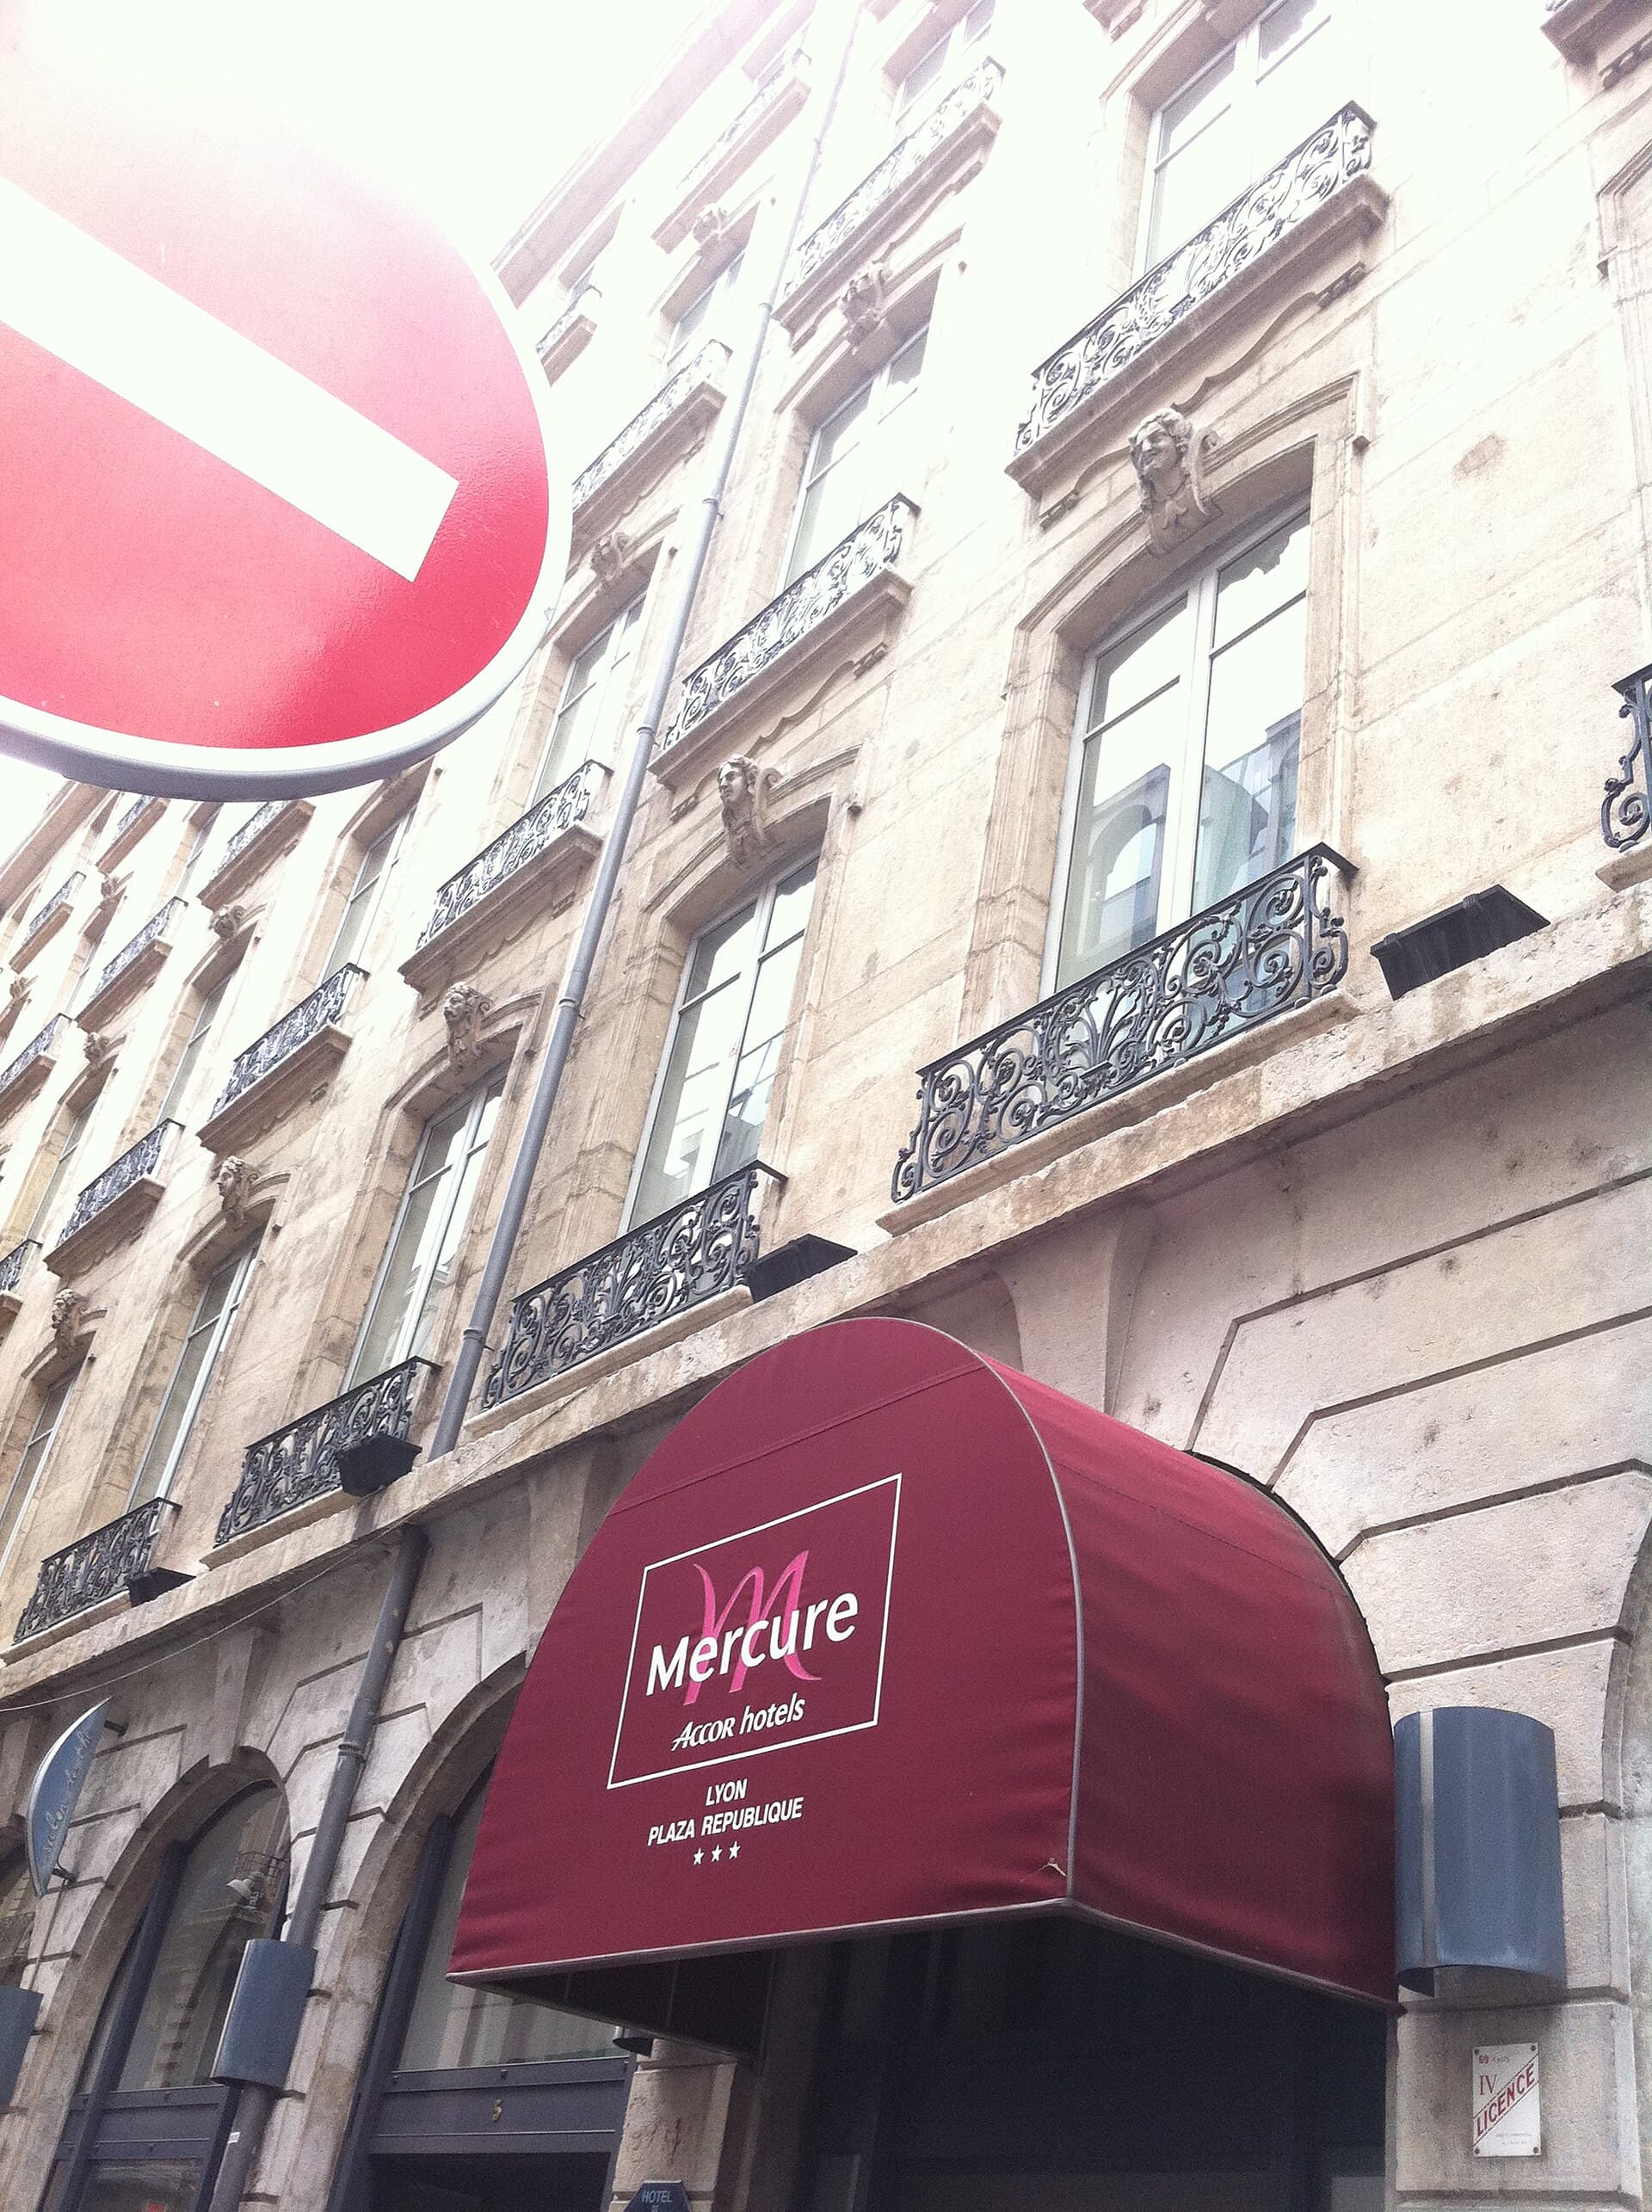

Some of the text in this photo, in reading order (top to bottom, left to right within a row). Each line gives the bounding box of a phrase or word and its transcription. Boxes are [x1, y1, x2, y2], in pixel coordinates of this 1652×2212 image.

[646, 1593, 857, 1695] Mercure
[740, 1693, 804, 1734] hotels
[706, 1779, 747, 1805] LYON
[648, 1797, 804, 1845] PLAZA REPUBLIQUE
[1476, 2062, 1535, 2136] LICENCE
[1479, 2074, 1497, 2095] IV
[641, 2190, 674, 2203] HOTEL
